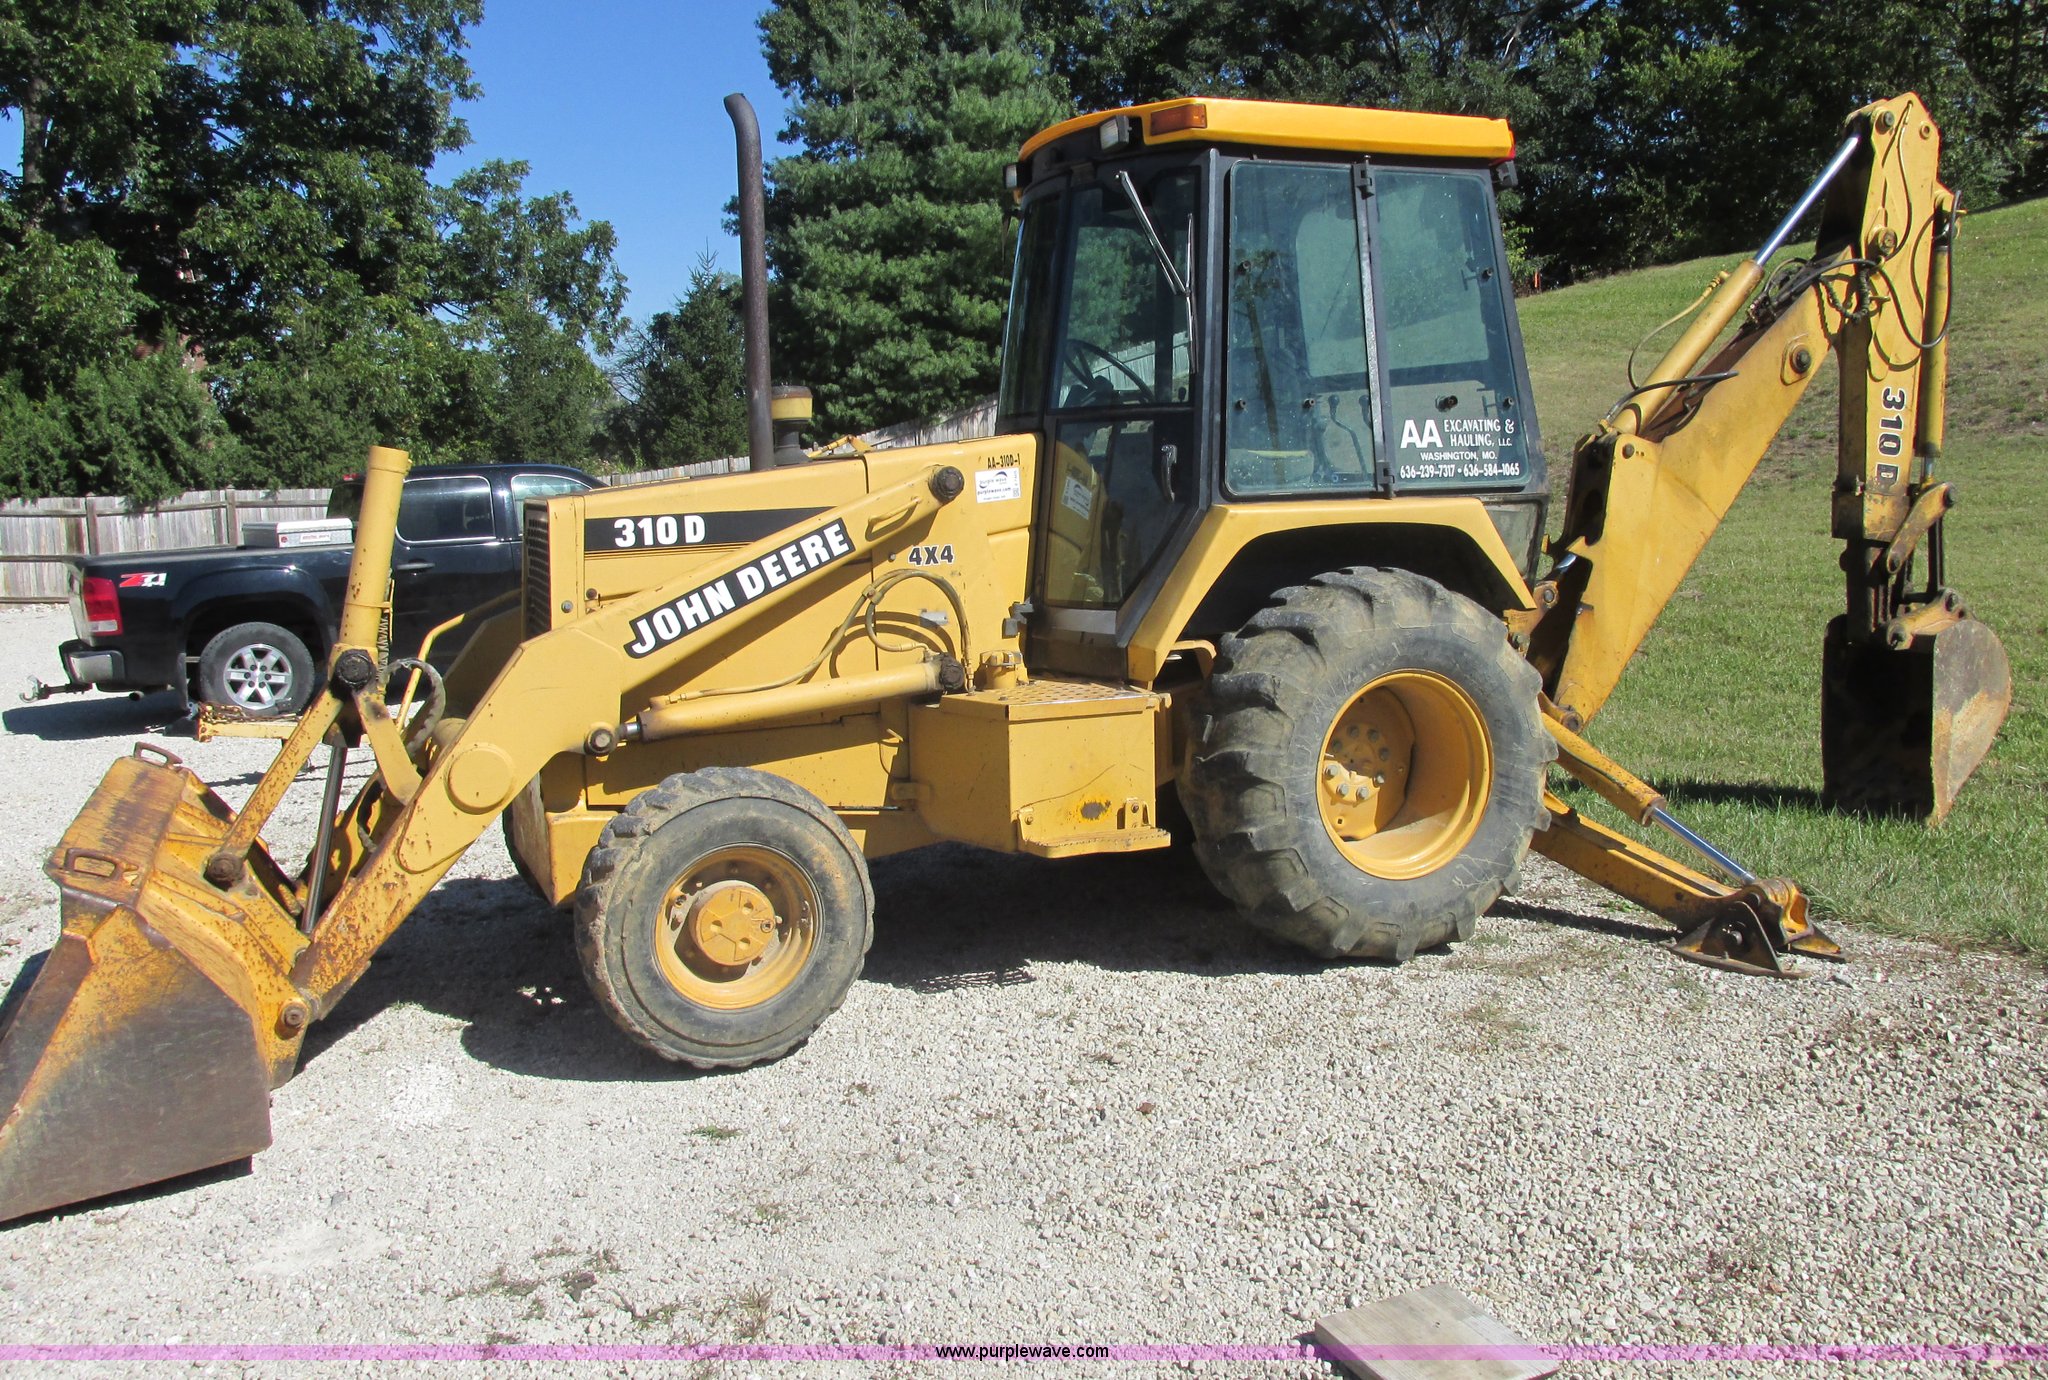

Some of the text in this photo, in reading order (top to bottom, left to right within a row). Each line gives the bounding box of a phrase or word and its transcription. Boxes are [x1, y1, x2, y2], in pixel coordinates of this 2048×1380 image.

[1400, 419, 1444, 449] AA
[1444, 418, 1515, 434] EXCAVATING &
[1450, 434, 1495, 448] HAULING,
[1875, 387, 1906, 491] 310 D
[987, 453, 1021, 470] AA-310D-1
[1420, 450, 1498, 462] WASHINGTON, MO.
[1400, 462, 1520, 479] 636-239-7317 636-584-1065
[614, 514, 706, 548] 310 D
[908, 544, 954, 566] 4X4
[631, 523, 850, 655] JOHN DEERE
